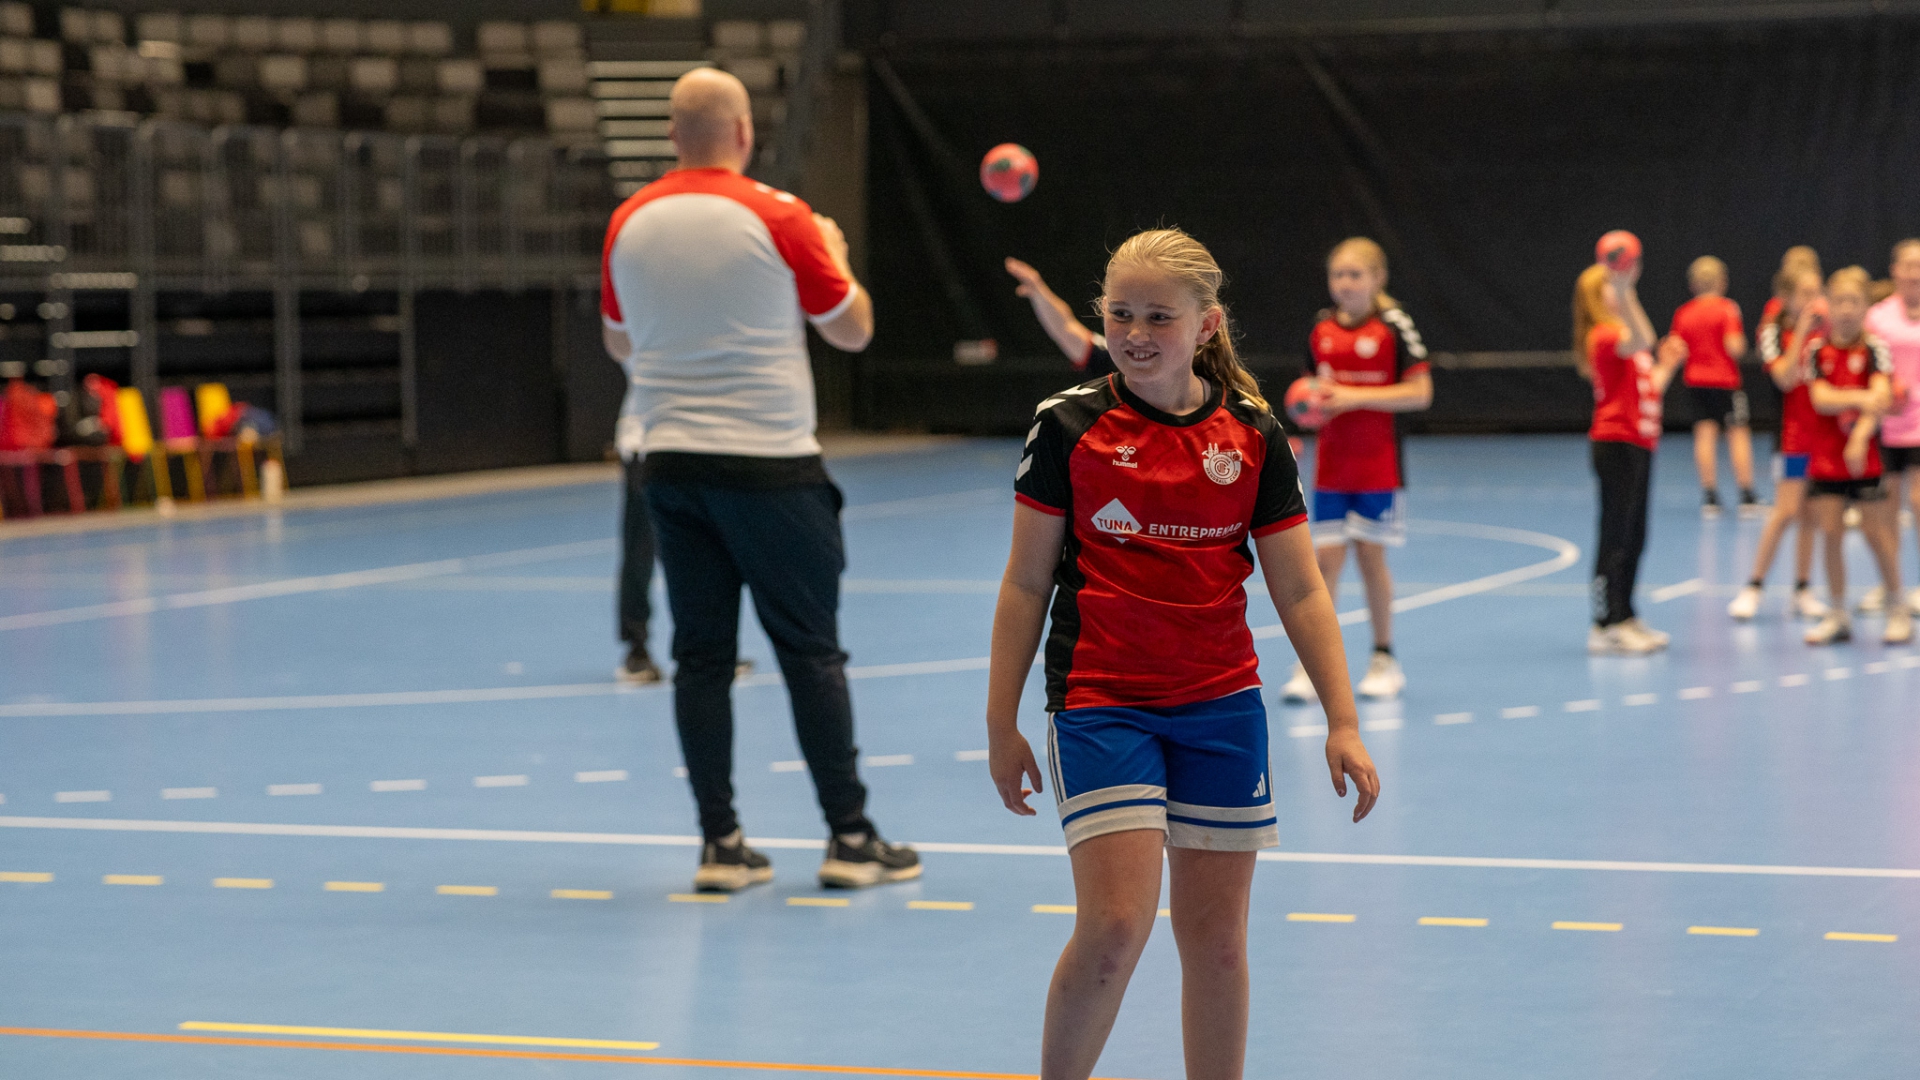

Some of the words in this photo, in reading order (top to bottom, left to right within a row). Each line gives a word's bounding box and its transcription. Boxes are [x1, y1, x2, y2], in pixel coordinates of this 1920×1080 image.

[1112, 458, 1138, 469] hummel
[1096, 517, 1133, 532] TUNA
[1148, 522, 1243, 539] ENTREPRENAD
